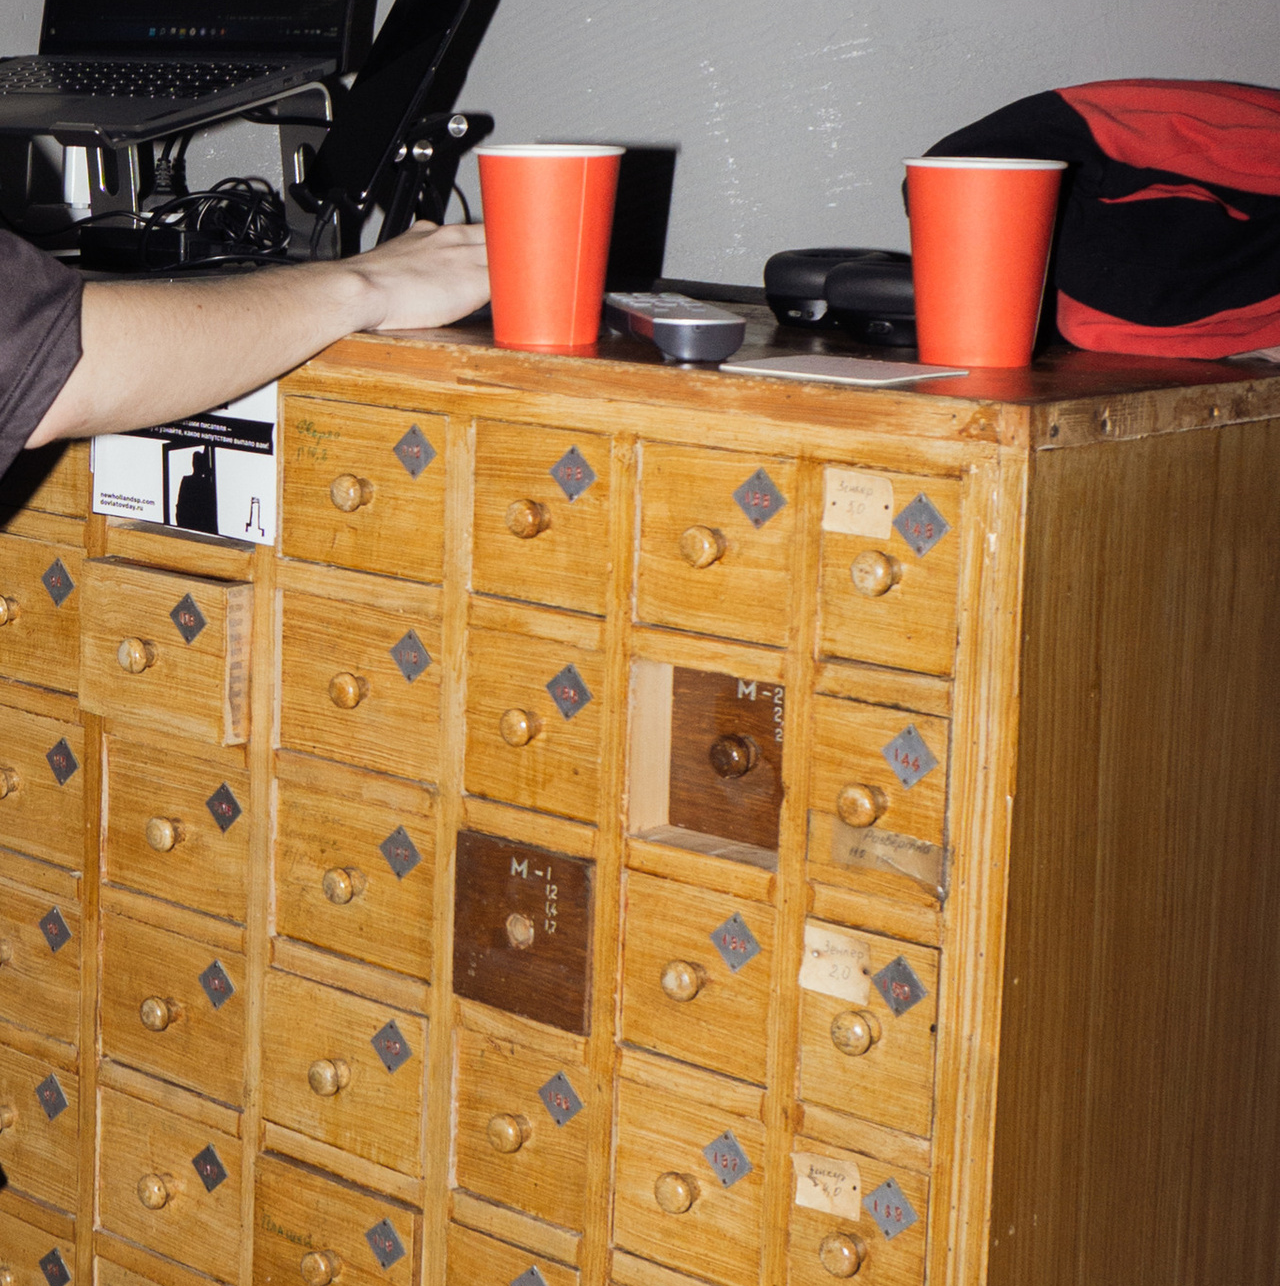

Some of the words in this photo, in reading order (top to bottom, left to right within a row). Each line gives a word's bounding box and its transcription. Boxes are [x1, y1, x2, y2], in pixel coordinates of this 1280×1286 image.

[184, 430, 201, 439] какое
[201, 432, 233, 444] напутствие
[100, 491, 155, 506] newhollandsp.com
[100, 499, 144, 512] dovlatovday.ru
